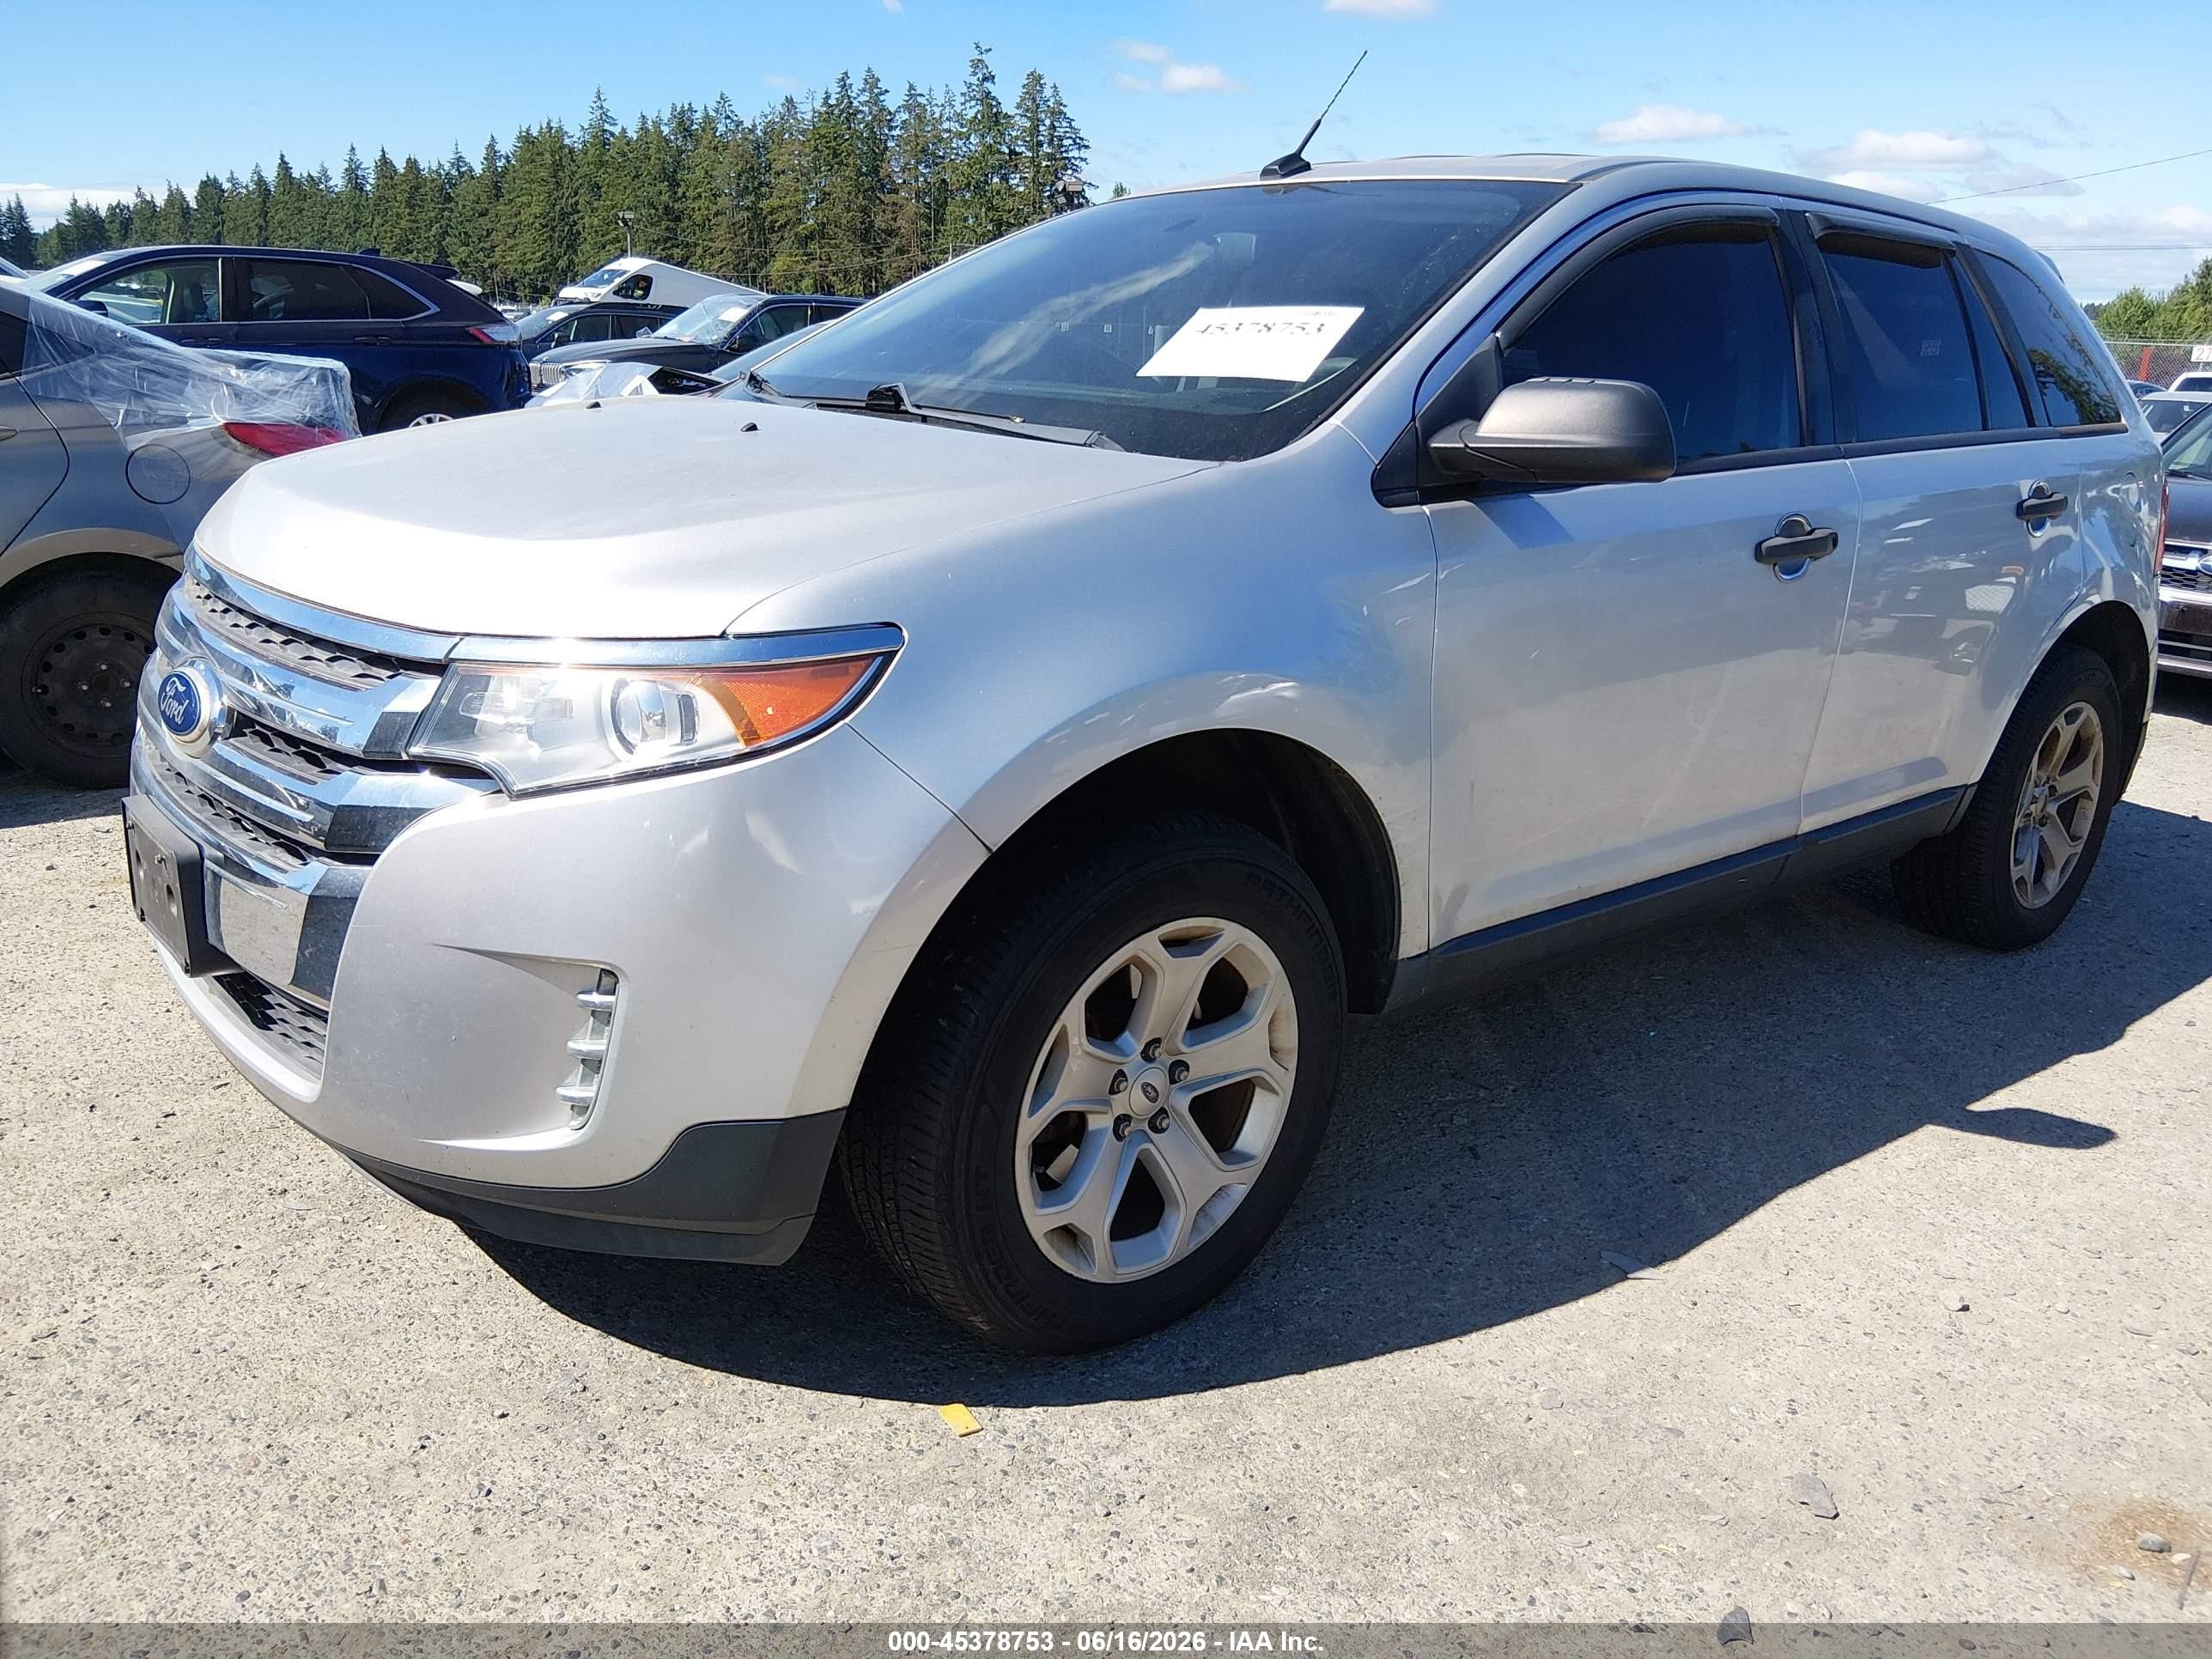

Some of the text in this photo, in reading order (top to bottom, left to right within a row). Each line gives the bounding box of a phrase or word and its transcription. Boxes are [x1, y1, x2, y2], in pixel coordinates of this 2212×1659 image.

[1194, 322, 1327, 336] 45378753
[2195, 346, 2212, 361] 27
[161, 677, 189, 725] Ford
